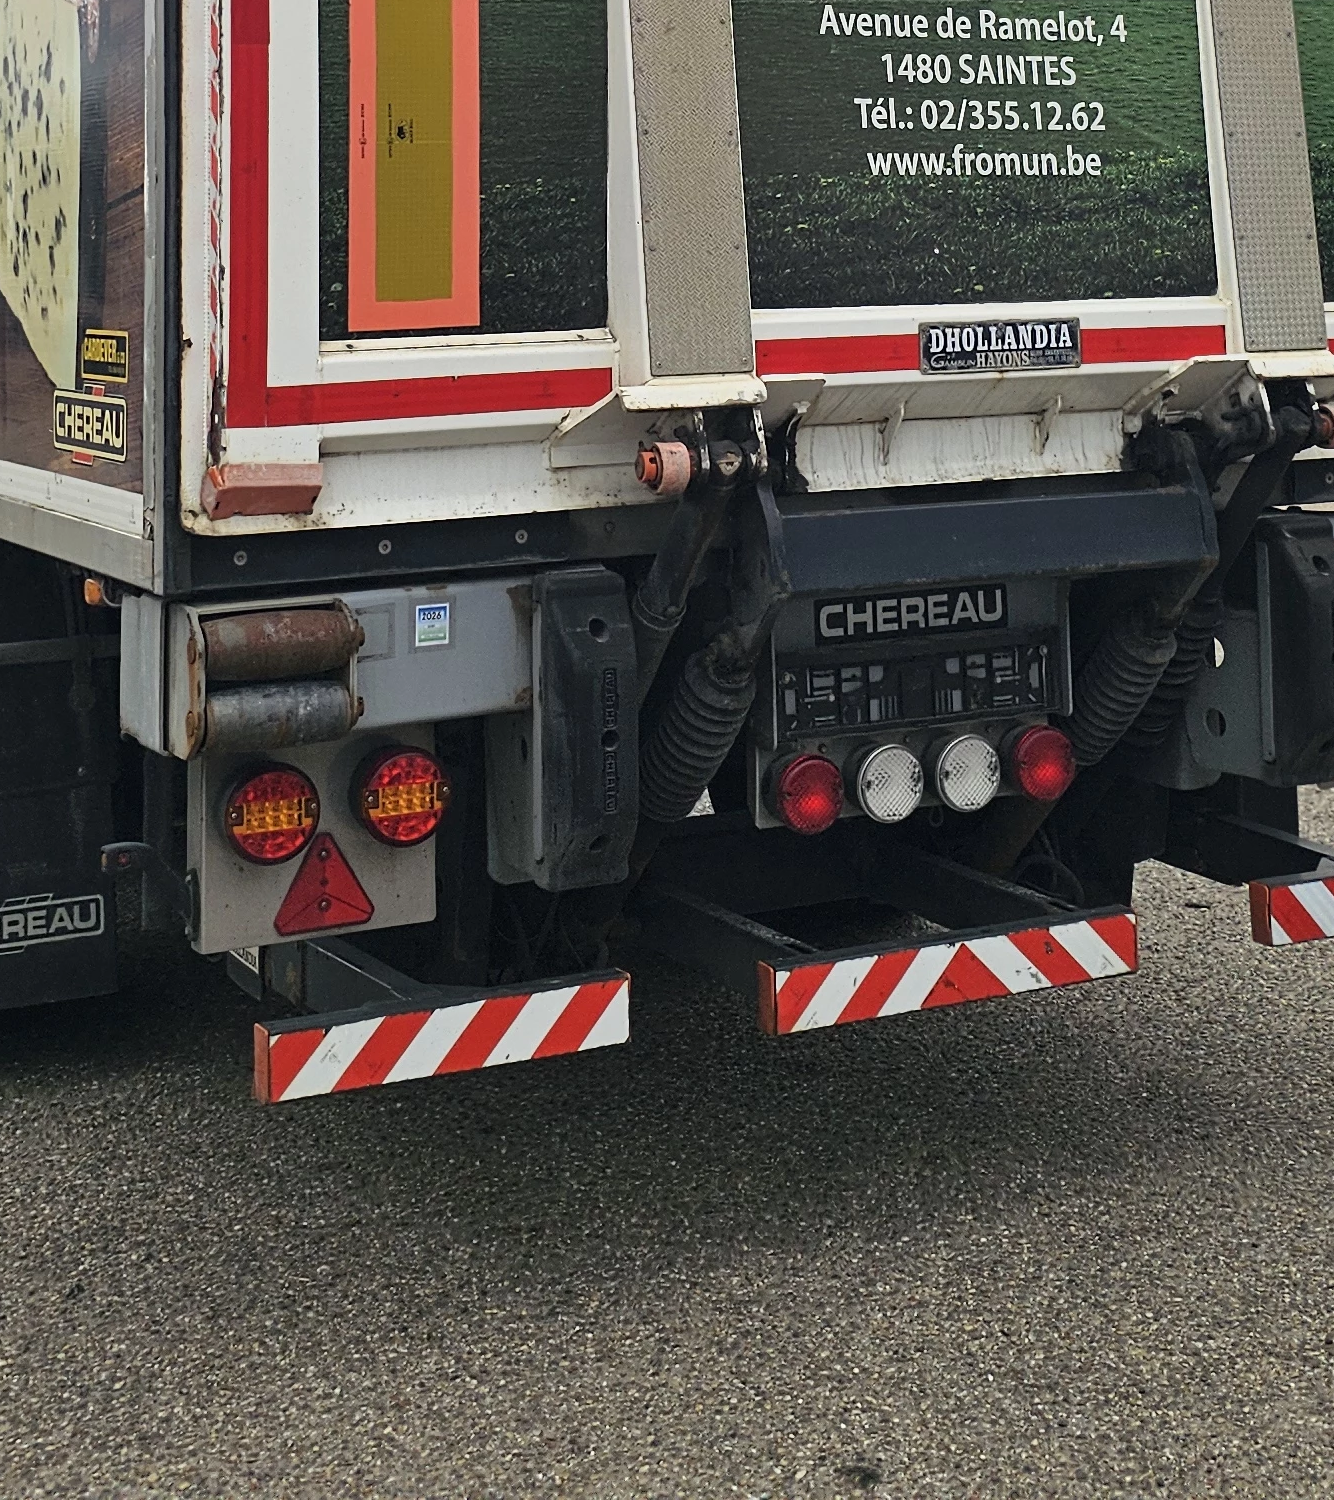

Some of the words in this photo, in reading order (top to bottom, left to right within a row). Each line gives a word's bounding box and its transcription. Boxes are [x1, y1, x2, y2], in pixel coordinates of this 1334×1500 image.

[819, 4, 929, 39] Avenue
[936, 7, 971, 40] de
[979, 10, 1104, 47] Ramelot,
[1110, 14, 1128, 43] 4
[880, 53, 951, 85] 1480
[959, 54, 1077, 86] SAINTES
[919, 100, 1106, 132] 02/355.12.62
[866, 144, 1102, 177] www.fromun.be
[929, 323, 1073, 353] DHOLLANDIA
[976, 350, 1031, 368] HAYONS
[56, 402, 123, 448] CHEREAU
[421, 611, 442, 621] 2026
[819, 589, 1003, 638] CHEREAU
